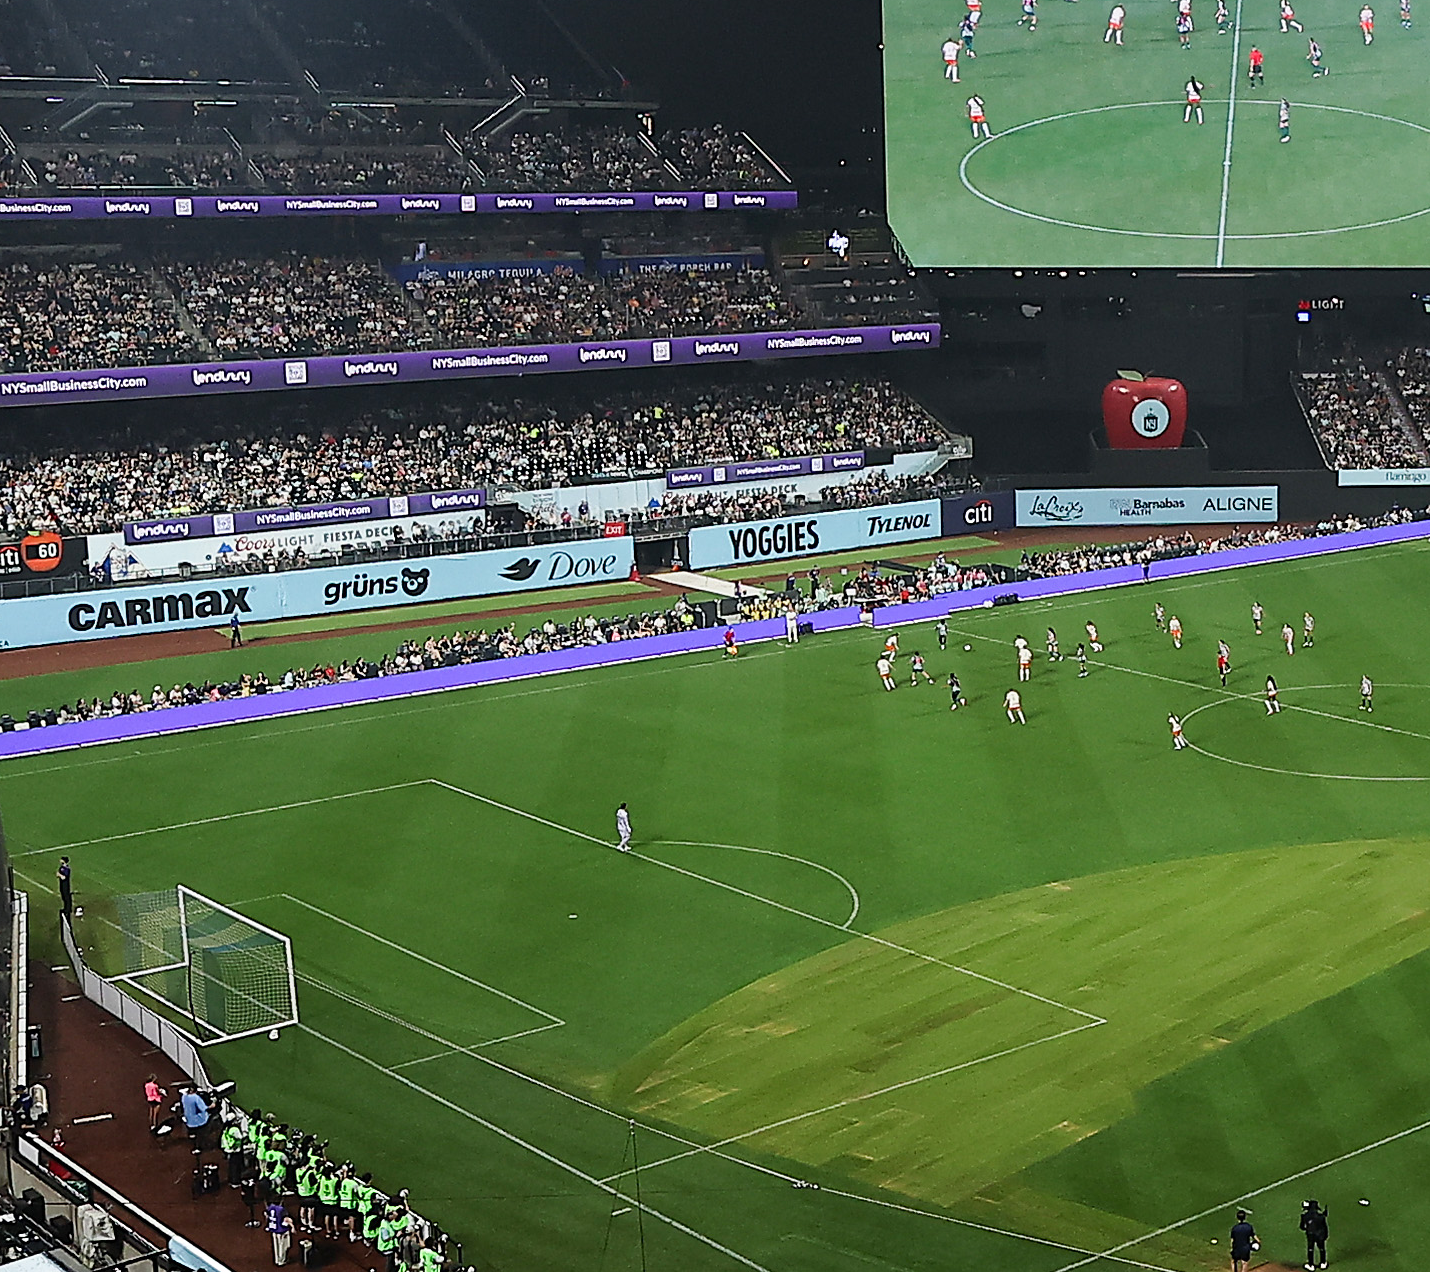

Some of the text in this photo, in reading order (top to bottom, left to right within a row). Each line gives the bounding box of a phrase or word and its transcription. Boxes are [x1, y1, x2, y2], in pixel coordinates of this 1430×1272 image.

[0, 376, 148, 395] NYSmallBusinessCity.com
[772, 484, 799, 495] DECK
[965, 501, 992, 525] citi
[1119, 509, 1152, 517] HEALTH
[1133, 498, 1186, 510] Barnabas
[1202, 497, 1274, 512] ALIGNE
[255, 503, 372, 527] NYSmallBusinessCity.com
[276, 529, 361, 549] LIGHT FIESTA
[605, 525, 623, 536] EXIT
[728, 512, 934, 560] YOGGIES TYLENOL
[38, 542, 58, 559] 60
[234, 532, 276, 553] Coors
[323, 573, 399, 606] grüns
[548, 550, 618, 583] Dove
